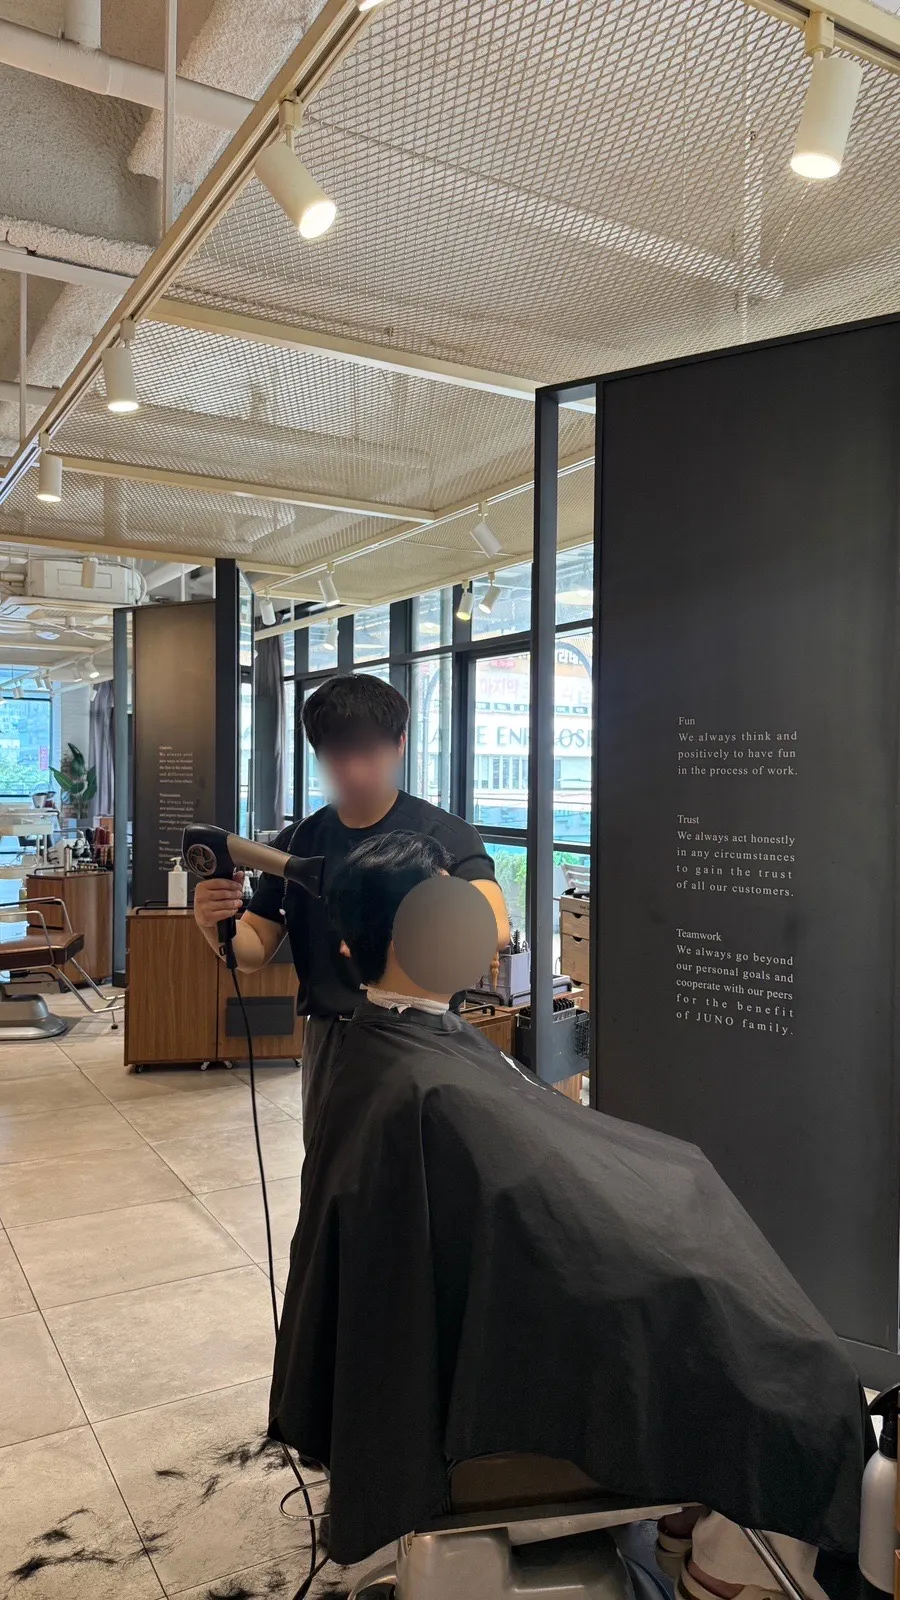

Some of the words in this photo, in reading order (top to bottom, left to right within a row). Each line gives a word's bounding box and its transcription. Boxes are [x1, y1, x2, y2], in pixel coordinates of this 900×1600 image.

[678, 716, 696, 725] Fun
[678, 733, 694, 742] We
[698, 732, 737, 743] always
[741, 731, 772, 741] think
[776, 731, 798, 741] and
[678, 749, 730, 761] positively
[733, 750, 744, 758] to
[748, 749, 773, 758] have
[778, 748, 796, 758] fun
[678, 765, 688, 775] in
[691, 766, 706, 775] the
[709, 766, 748, 777] process
[752, 766, 765, 775] of
[767, 766, 798, 775] work.
[677, 815, 700, 824] Trust
[677, 831, 692, 840] We
[695, 832, 729, 844] always
[750, 834, 796, 847] honestly
[677, 847, 687, 856] in
[691, 849, 710, 860] any
[714, 849, 795, 862] circumstances
[676, 864, 688, 873] to
[695, 865, 723, 876] gain
[730, 867, 751, 877] the
[759, 869, 792, 879] trust
[676, 880, 688, 889] of
[691, 881, 705, 890] all
[709, 883, 728, 892] our
[732, 885, 794, 897] customers.
[676, 928, 722, 942] Teamwork
[676, 945, 692, 955] We
[695, 947, 732, 960] always
[735, 953, 749, 962] go
[753, 953, 794, 966] beyond
[676, 963, 693, 971] our
[695, 964, 739, 977] personal
[743, 970, 771, 980] goals
[774, 974, 794, 983] and
[676, 979, 721, 991] cooperate
[723, 984, 745, 994] with
[747, 988, 764, 997] our
[766, 990, 793, 1000] peers
[676, 993, 697, 1004] for
[706, 998, 728, 1009] the
[737, 1001, 794, 1018] benefit
[676, 1011, 690, 1020] of
[696, 1012, 734, 1026] JUNO
[742, 1019, 794, 1036] family.
